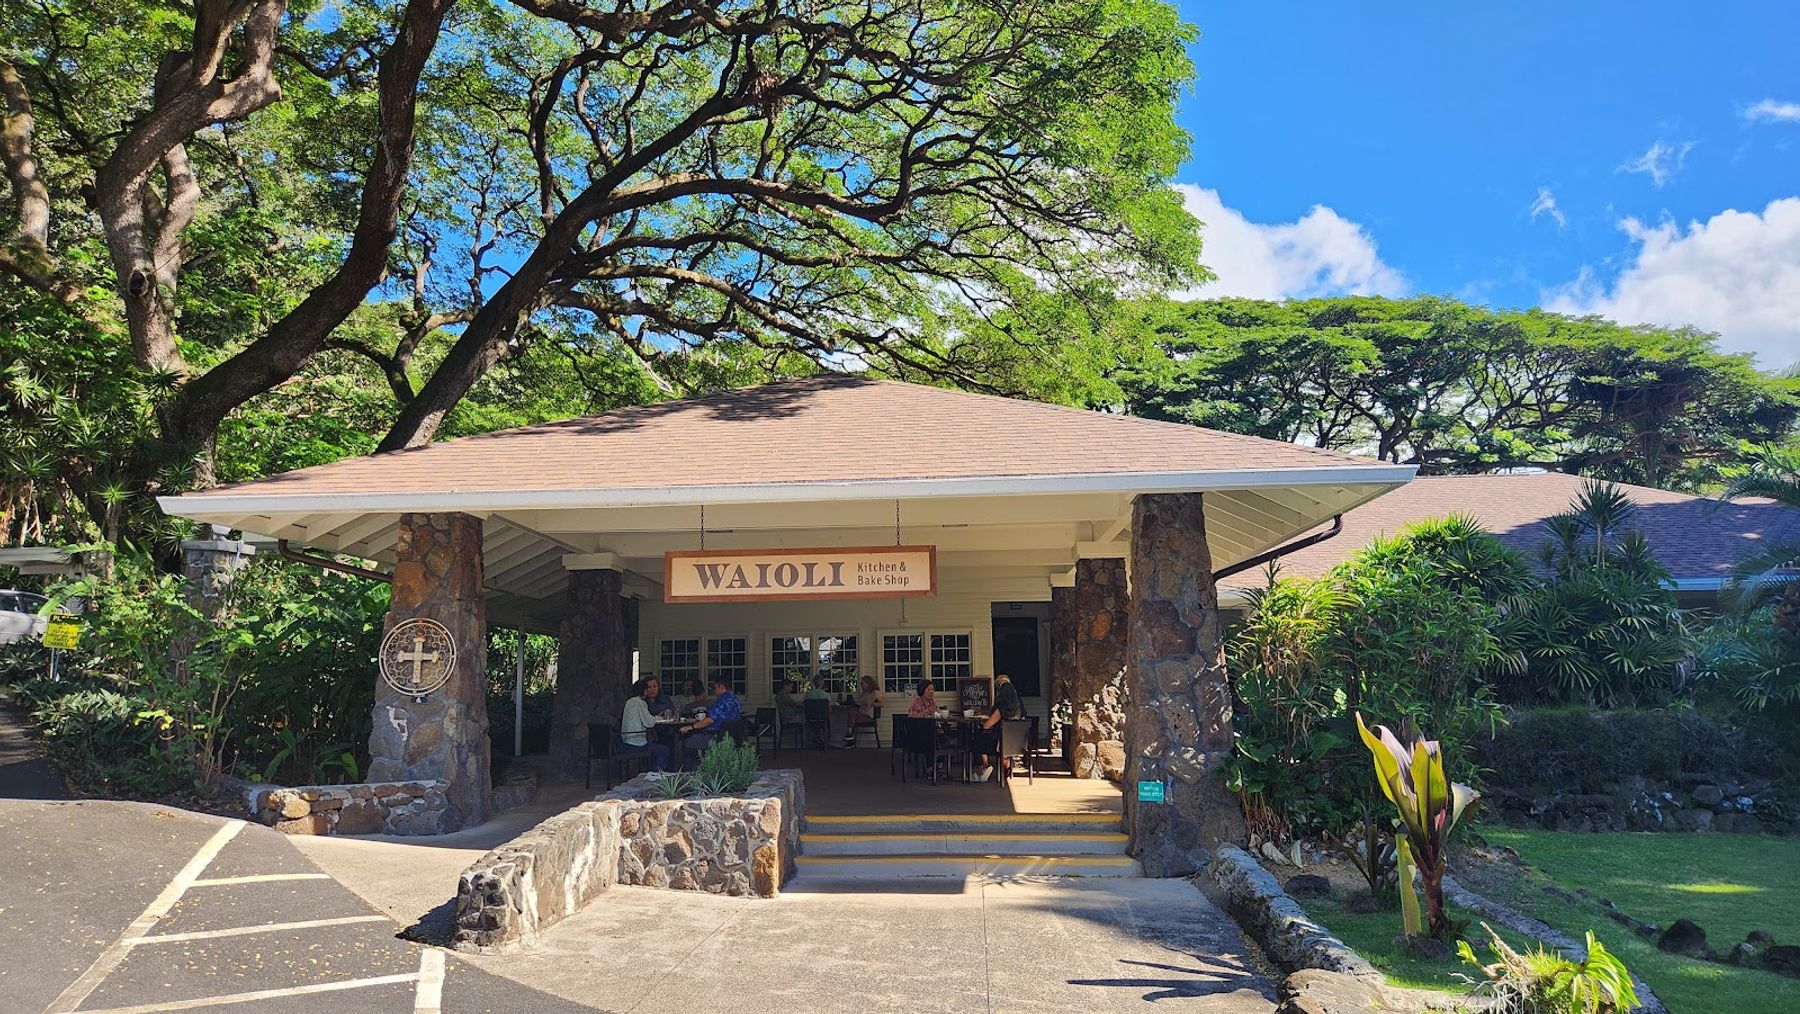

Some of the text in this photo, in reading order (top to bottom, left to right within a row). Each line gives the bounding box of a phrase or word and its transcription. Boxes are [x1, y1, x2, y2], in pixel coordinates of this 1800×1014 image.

[857, 561, 908, 572] Kitchen &
[693, 562, 845, 589] WAIOLI
[857, 574, 909, 587] Bake Shop
